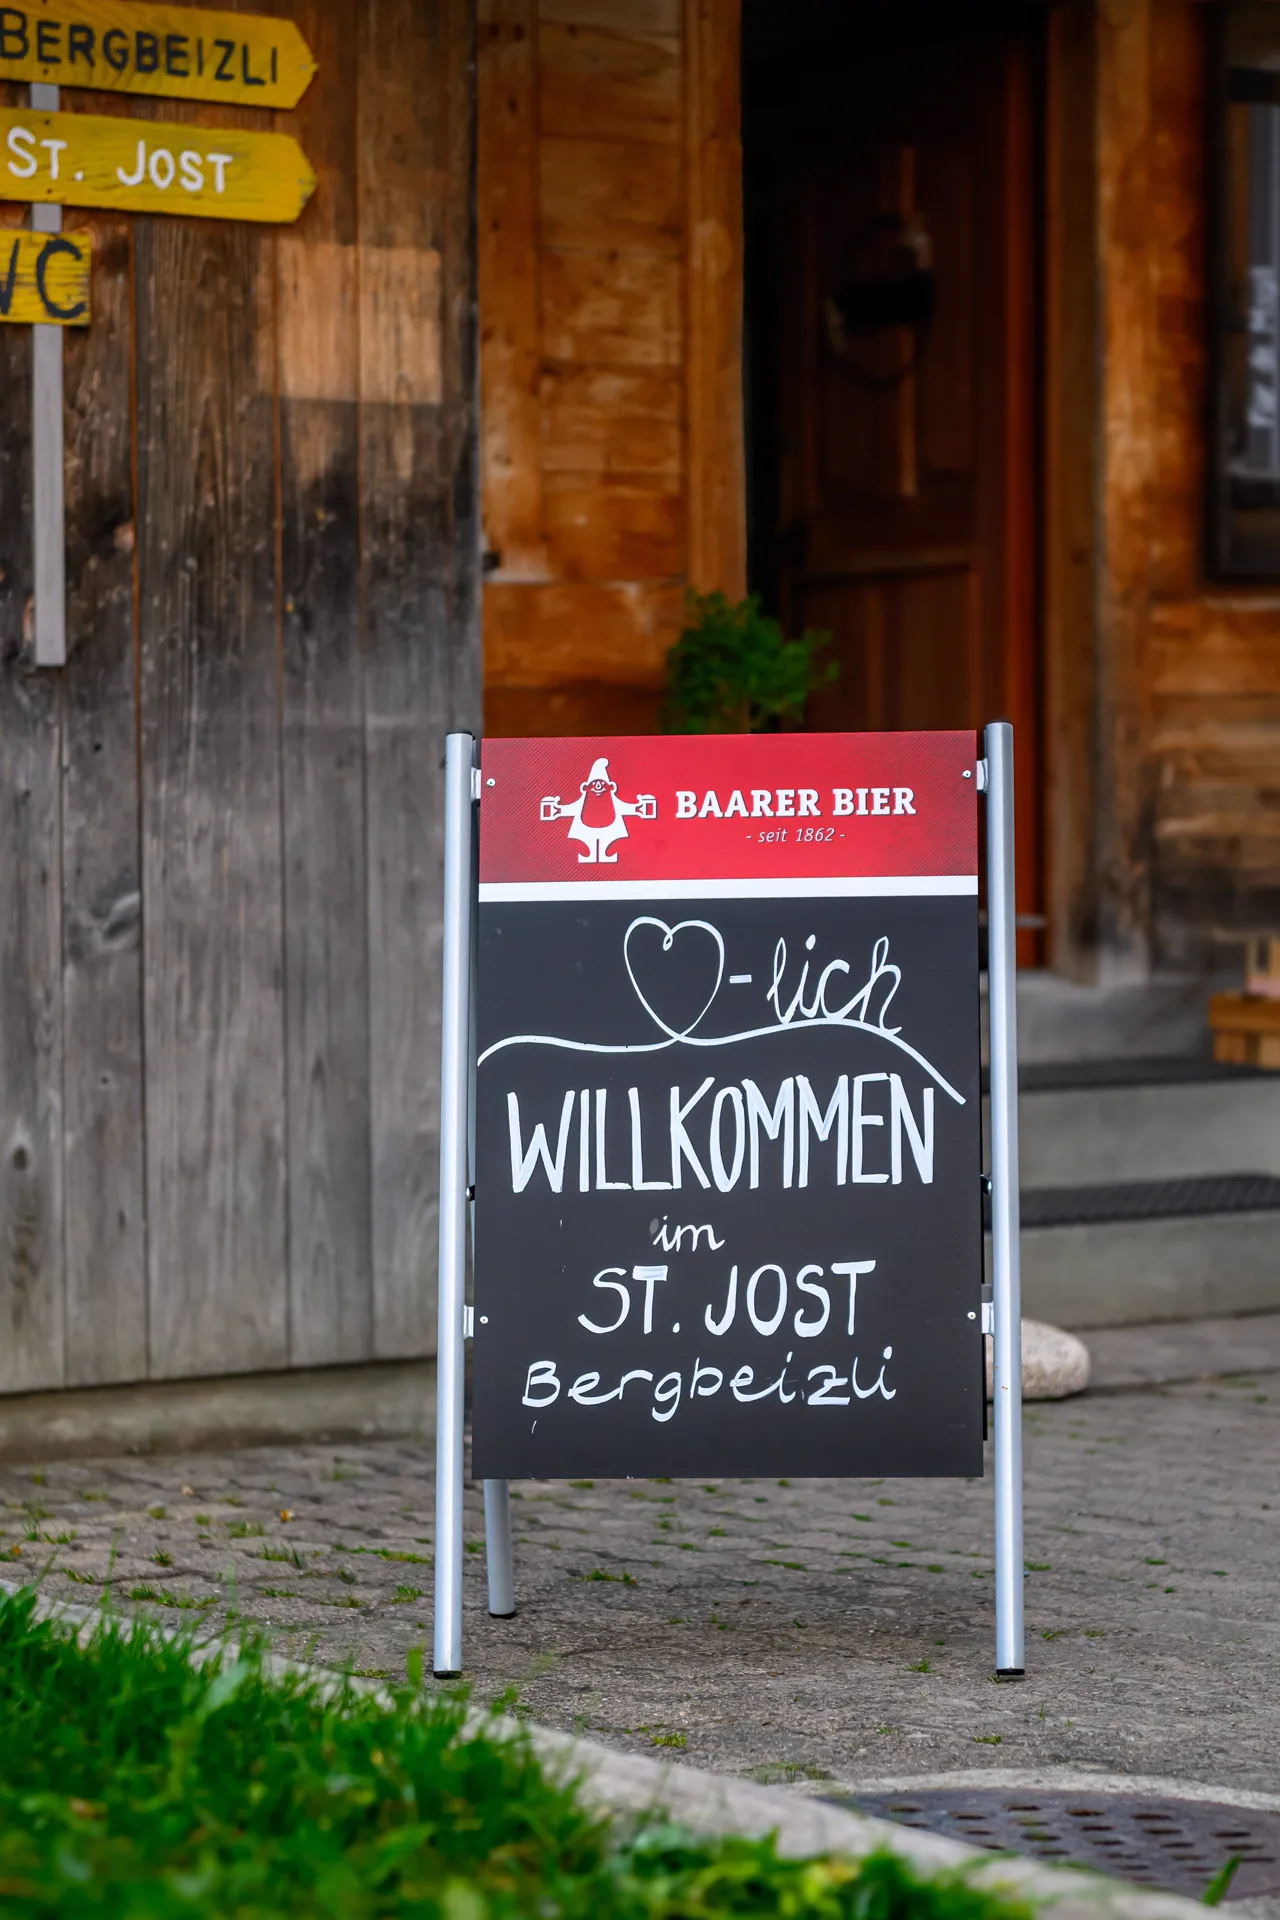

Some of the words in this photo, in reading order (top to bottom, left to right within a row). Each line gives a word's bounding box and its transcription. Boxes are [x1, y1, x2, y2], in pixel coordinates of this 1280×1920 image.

[0, 8, 278, 85] BERGBEIZLI
[7, 126, 84, 181] ST.
[116, 139, 234, 193] JOST
[675, 789, 822, 819] BAARER
[832, 787, 918, 816] BIER
[757, 828, 788, 843] seit
[795, 827, 835, 842] 1862
[507, 1072, 935, 1194] WILLKOMMEN
[652, 1215, 725, 1252] im
[577, 1264, 681, 1335] ST.
[704, 1259, 877, 1337] JOST
[521, 1345, 897, 1423] Bergbeizli
